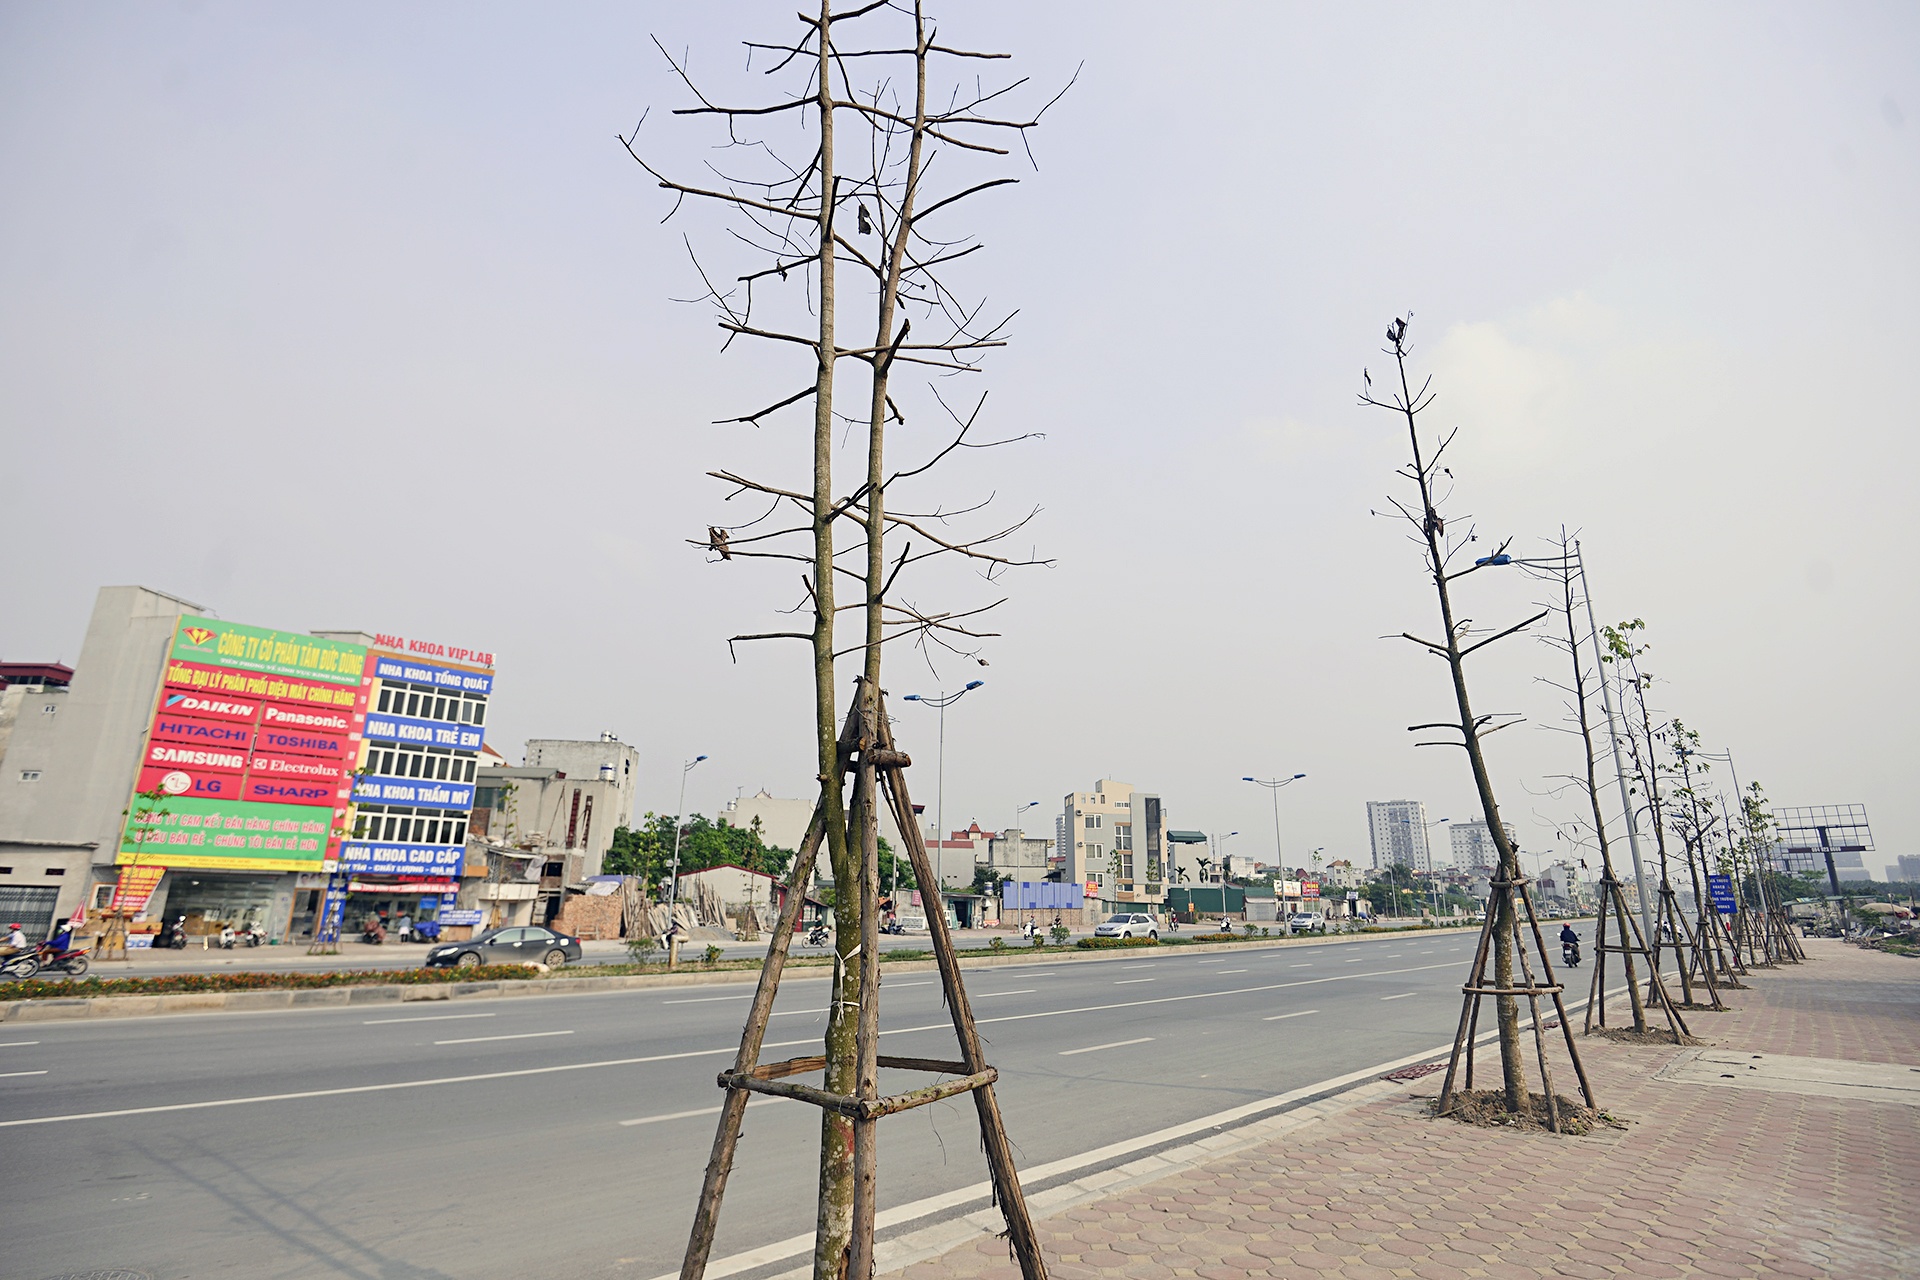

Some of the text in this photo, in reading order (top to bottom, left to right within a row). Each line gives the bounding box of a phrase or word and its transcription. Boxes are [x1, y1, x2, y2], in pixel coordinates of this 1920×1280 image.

[217, 629, 247, 657] CÔNG
[245, 636, 260, 659] TY
[374, 633, 405, 650] NHA
[408, 639, 445, 656] KHOA
[192, 669, 210, 689] ĐẠI
[208, 670, 222, 689] LÝ
[268, 679, 289, 700] ĐIỆN
[288, 682, 309, 700] MÁY
[308, 685, 334, 704] CHÍNH
[331, 674, 356, 683] DOANH
[378, 663, 489, 691] NHA KHOA TỔNG QUÁT
[181, 698, 254, 716] DAIKIN
[265, 708, 348, 729] Panasonic
[160, 722, 247, 742] HITACHI
[366, 720, 481, 747] NHA KHOA TRẺ EM
[266, 734, 339, 751] TOSHIBA
[151, 747, 245, 769] SAMSUNG
[269, 759, 339, 777] Electrolux
[195, 779, 222, 793] LG
[253, 784, 329, 799] SHARP
[354, 782, 381, 799] NHA
[382, 785, 415, 801] KHOA
[166, 812, 178, 827] TY
[180, 813, 202, 828] CAM
[203, 811, 223, 828] KẾT
[224, 814, 243, 829] BÁN
[272, 817, 300, 832] CHÍNH
[169, 830, 189, 845] BÁN
[214, 832, 246, 848] CHÚNG
[247, 833, 263, 849] TÔI
[265, 834, 284, 850] BÁN
[344, 846, 461, 864] NHA KHOA CAO CẤP
